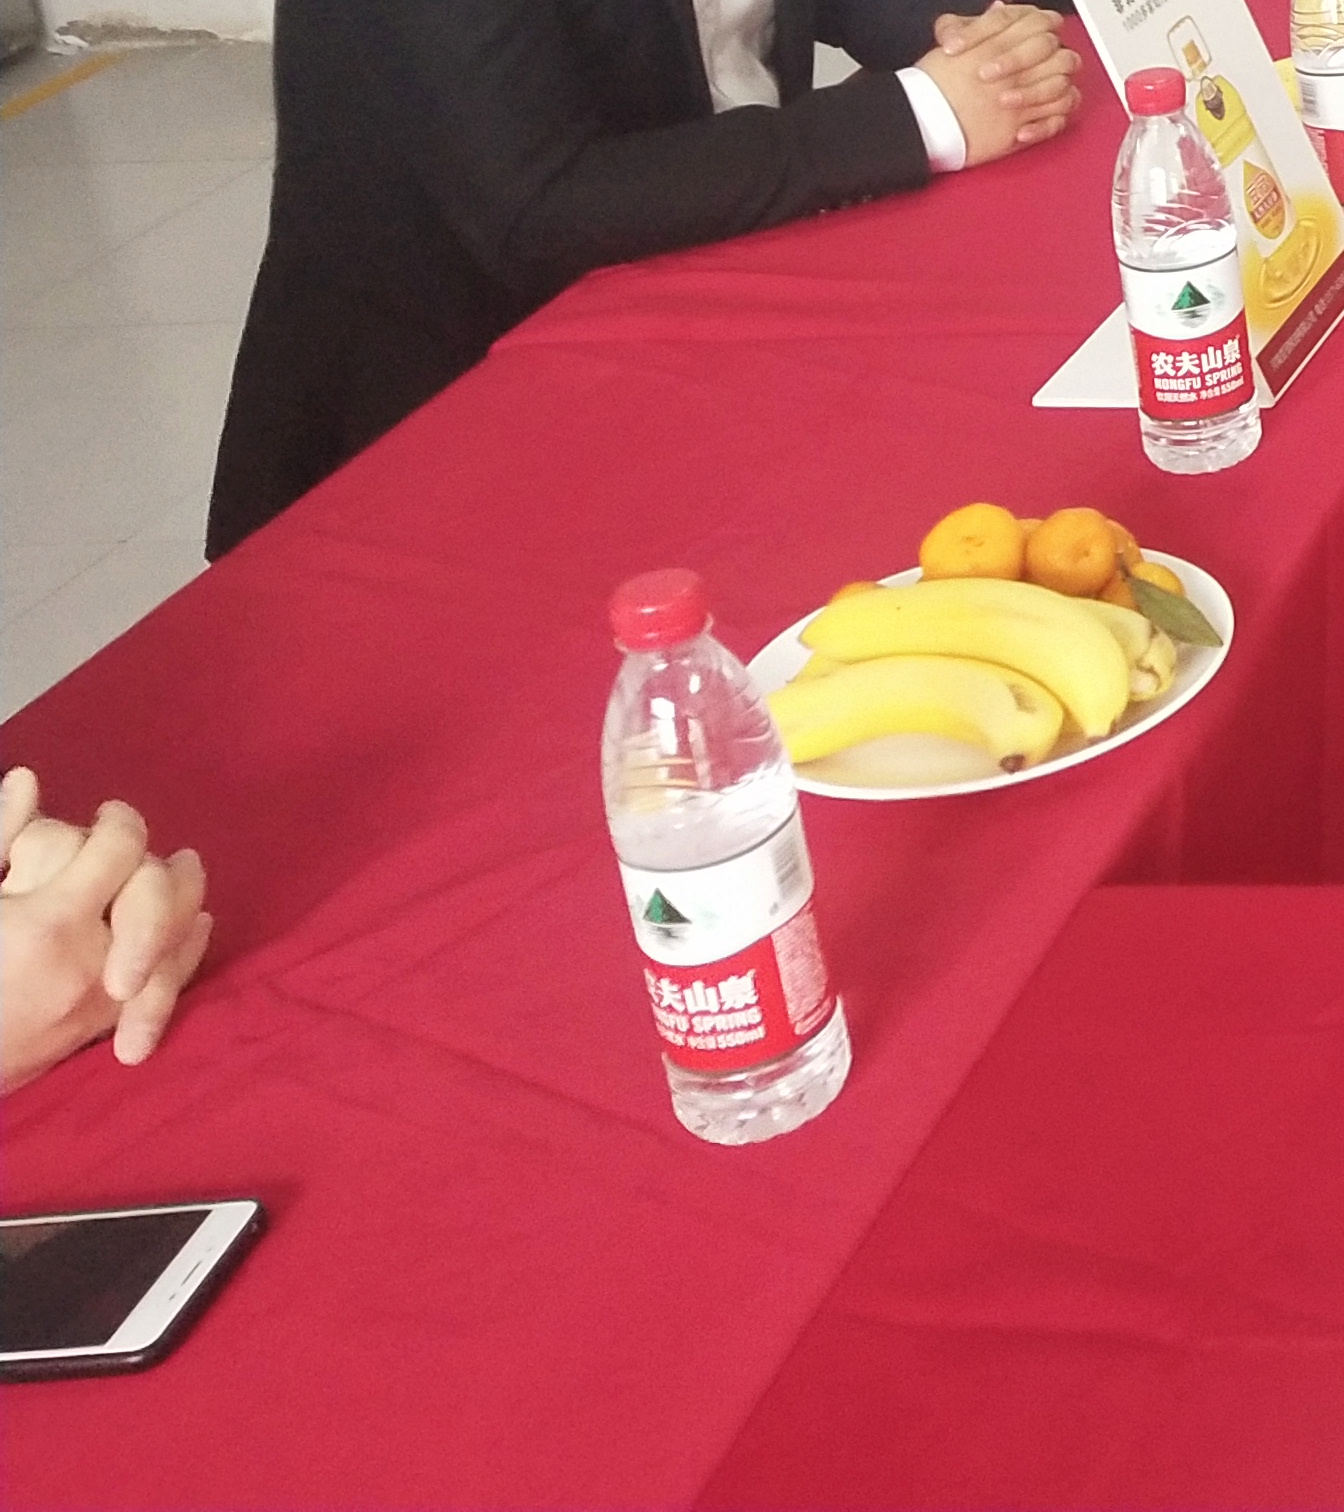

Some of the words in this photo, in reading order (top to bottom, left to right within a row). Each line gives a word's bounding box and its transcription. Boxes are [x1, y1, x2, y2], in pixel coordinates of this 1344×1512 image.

[1150, 338, 1241, 377] 农夫山泉
[1153, 375, 1203, 392] NONGFU
[1204, 362, 1243, 387] SPRING
[691, 1006, 763, 1034] SPRING
